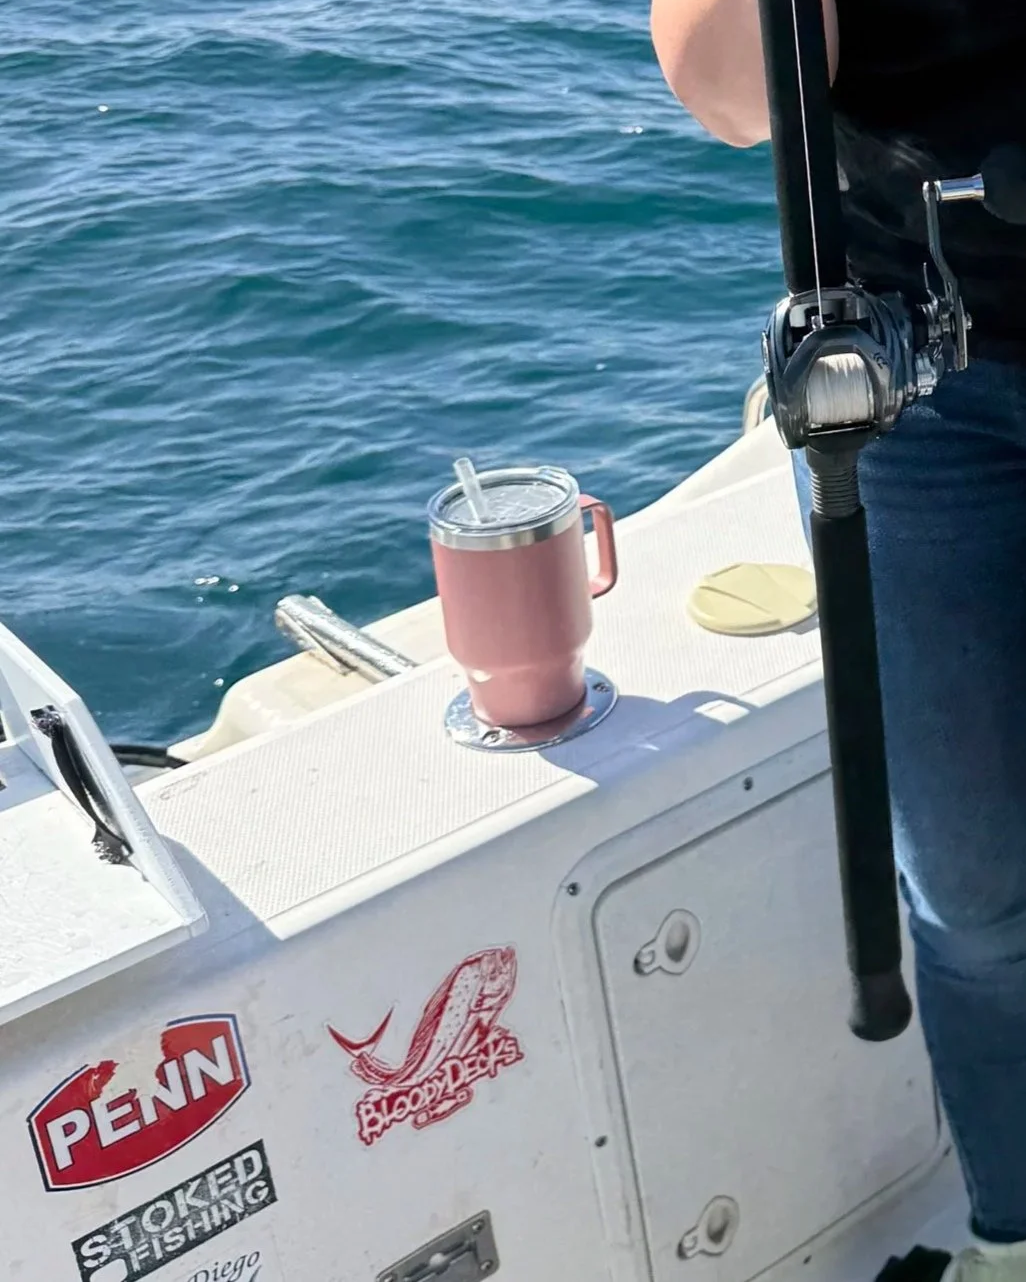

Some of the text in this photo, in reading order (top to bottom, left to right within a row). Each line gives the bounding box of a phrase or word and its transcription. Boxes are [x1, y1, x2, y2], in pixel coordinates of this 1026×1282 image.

[46, 1034, 236, 1172] PENN
[80, 1149, 263, 1268] STOKED
[129, 1180, 269, 1272] FISHING
